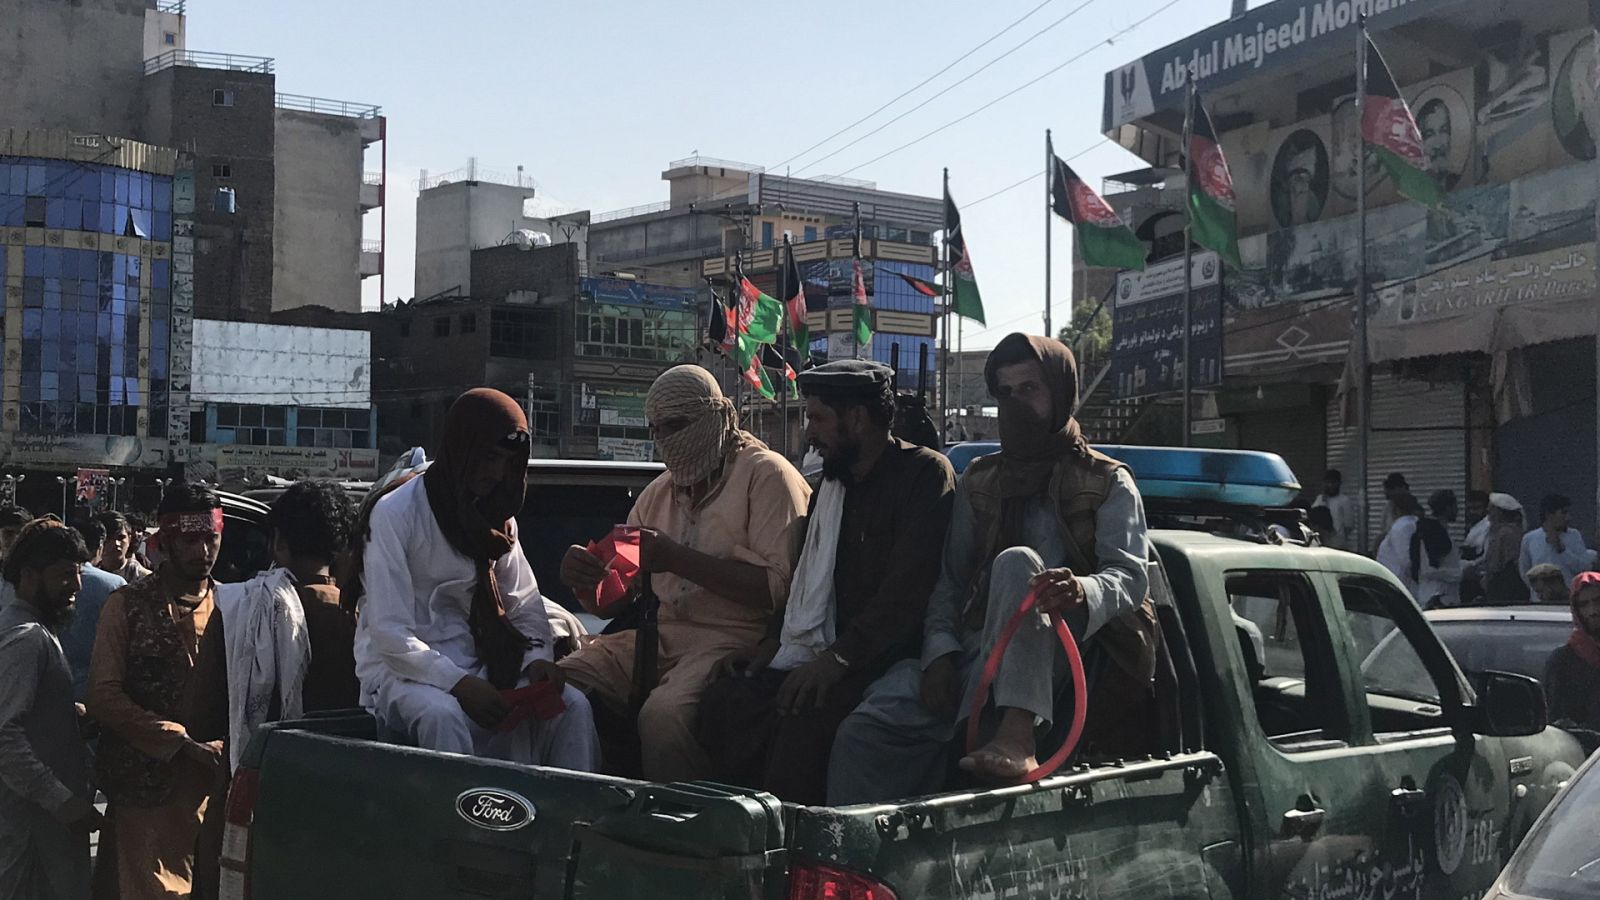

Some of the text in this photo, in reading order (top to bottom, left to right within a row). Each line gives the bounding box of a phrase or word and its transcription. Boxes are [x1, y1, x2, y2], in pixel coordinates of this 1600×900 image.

[1160, 40, 1219, 95] Abdul
[1222, 8, 1306, 69] Majeed
[472, 795, 515, 822] Ford
